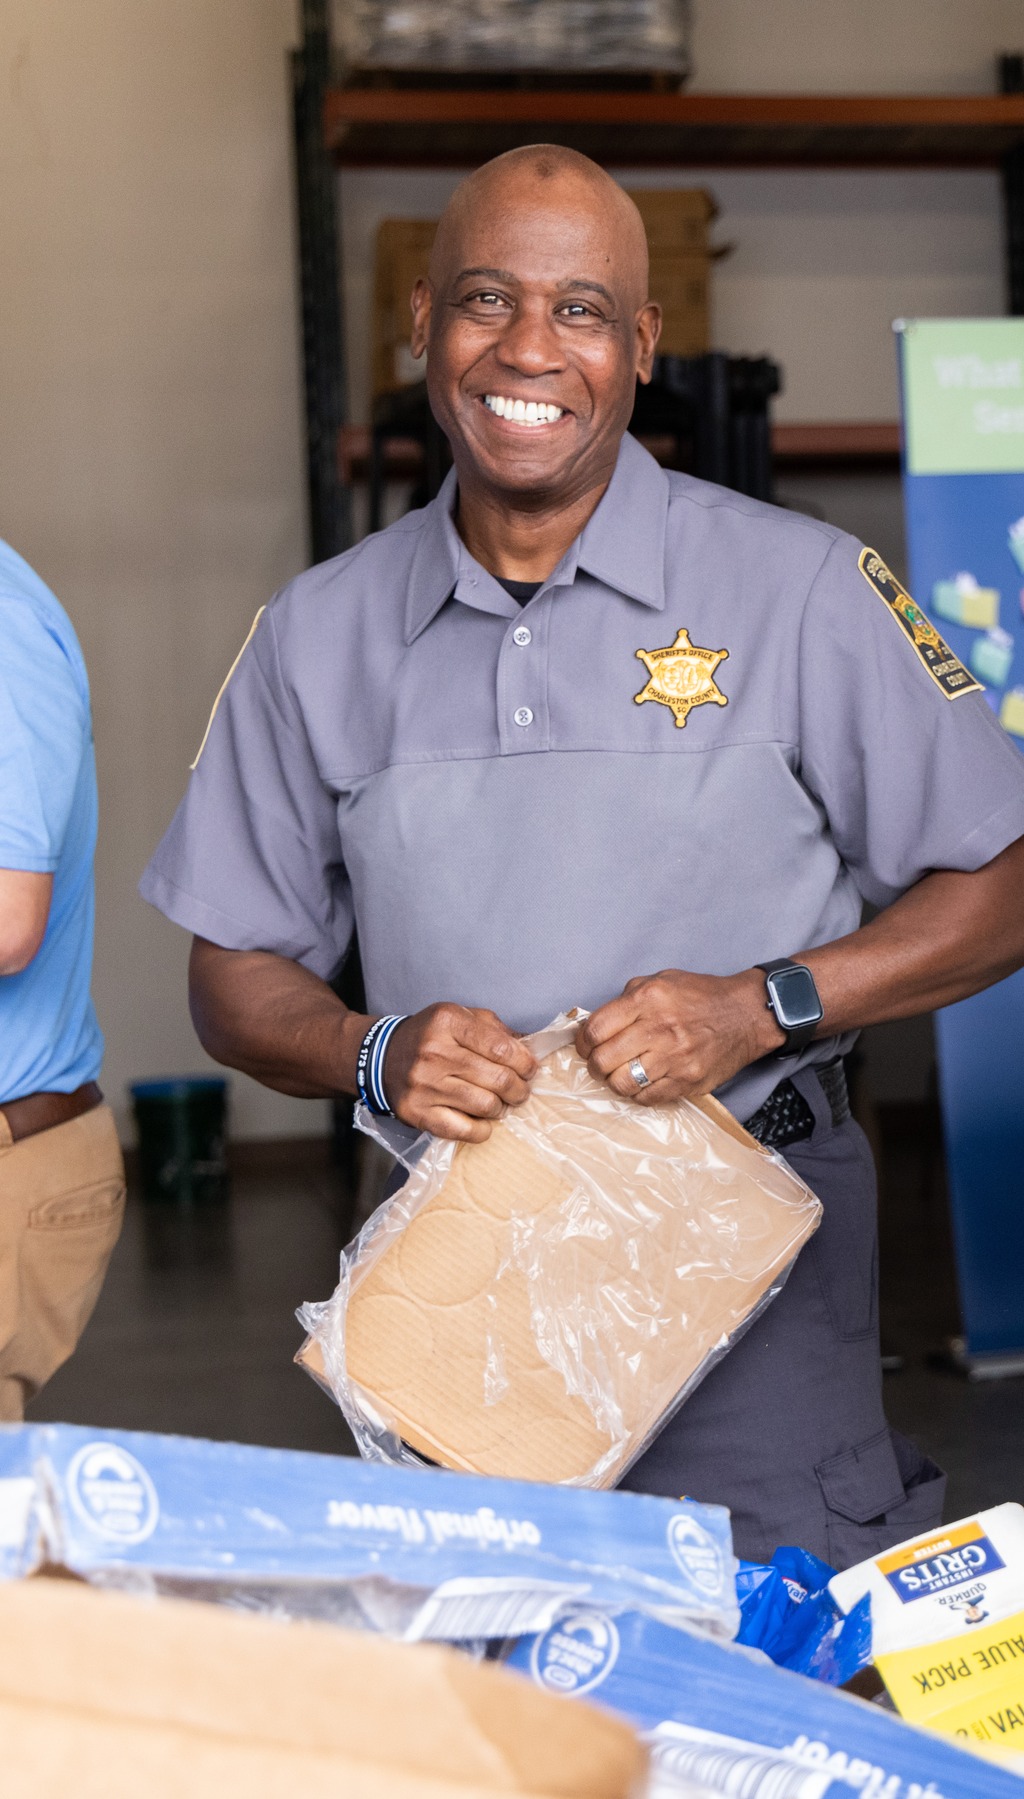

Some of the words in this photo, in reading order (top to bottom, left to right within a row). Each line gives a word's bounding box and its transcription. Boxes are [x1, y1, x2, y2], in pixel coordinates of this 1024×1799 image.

[934, 354, 1021, 389] What
[689, 649, 713, 660] OFFICE
[647, 687, 689, 705] CHARLESTON
[690, 687, 716, 704] COUNTY
[358, 1048, 369, 1067] 173
[327, 1499, 426, 1543] flavor
[424, 1506, 542, 1551] original
[913, 1540, 953, 1559] BUTTER
[898, 1544, 987, 1591] GRITS
[929, 1567, 974, 1591] INSTANT
[938, 1582, 987, 1606] QUAKER
[912, 1657, 973, 1695] PACK
